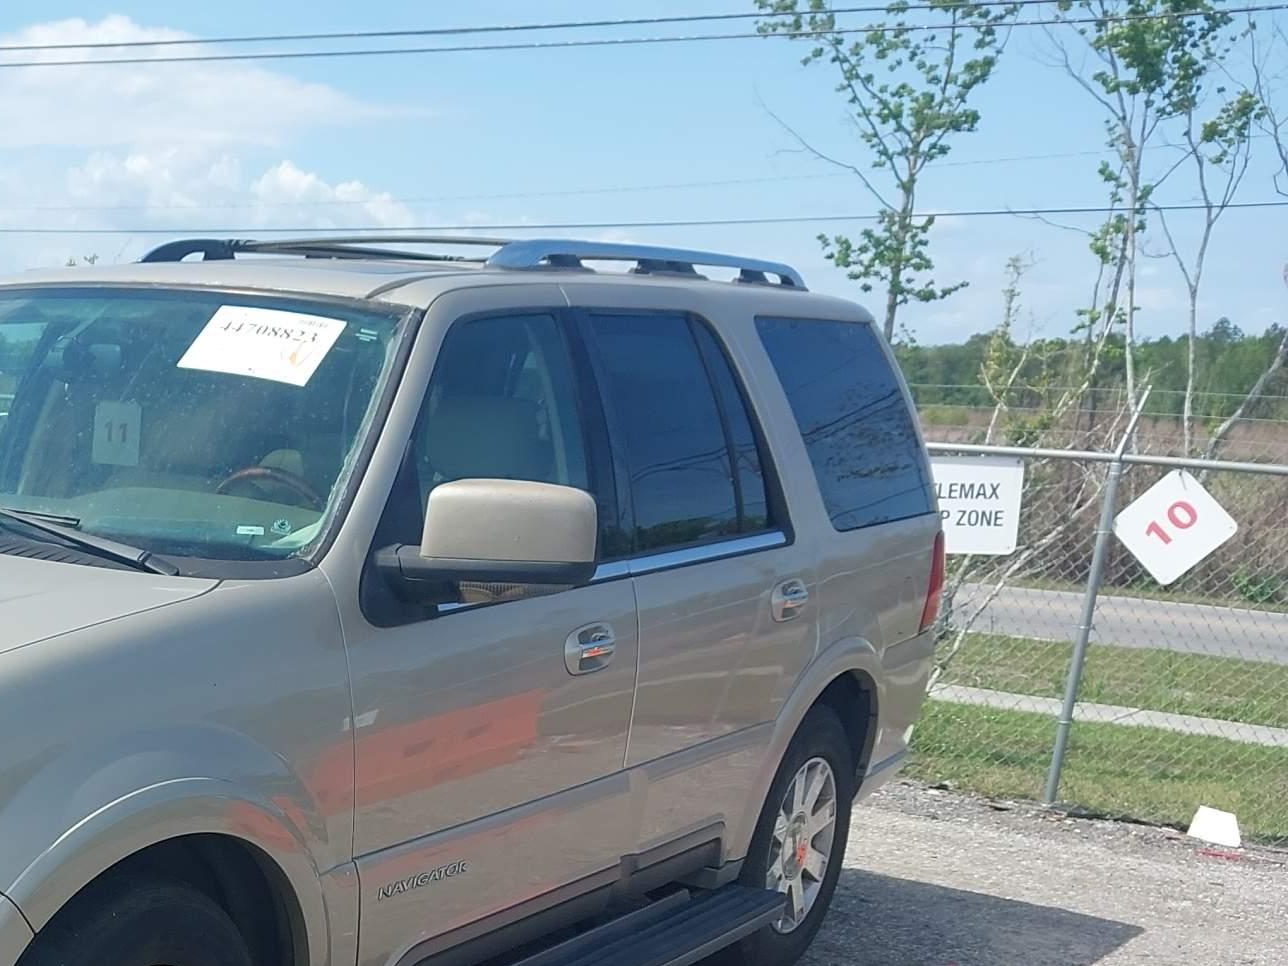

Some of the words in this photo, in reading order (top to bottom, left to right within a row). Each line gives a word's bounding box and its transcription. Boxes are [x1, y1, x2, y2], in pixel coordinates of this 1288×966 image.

[220, 321, 319, 343] 44708823
[104, 421, 128, 443] 11
[955, 509, 1005, 527] ZONE
[1145, 501, 1198, 545] 10
[377, 861, 468, 901] NAVIGATOR
